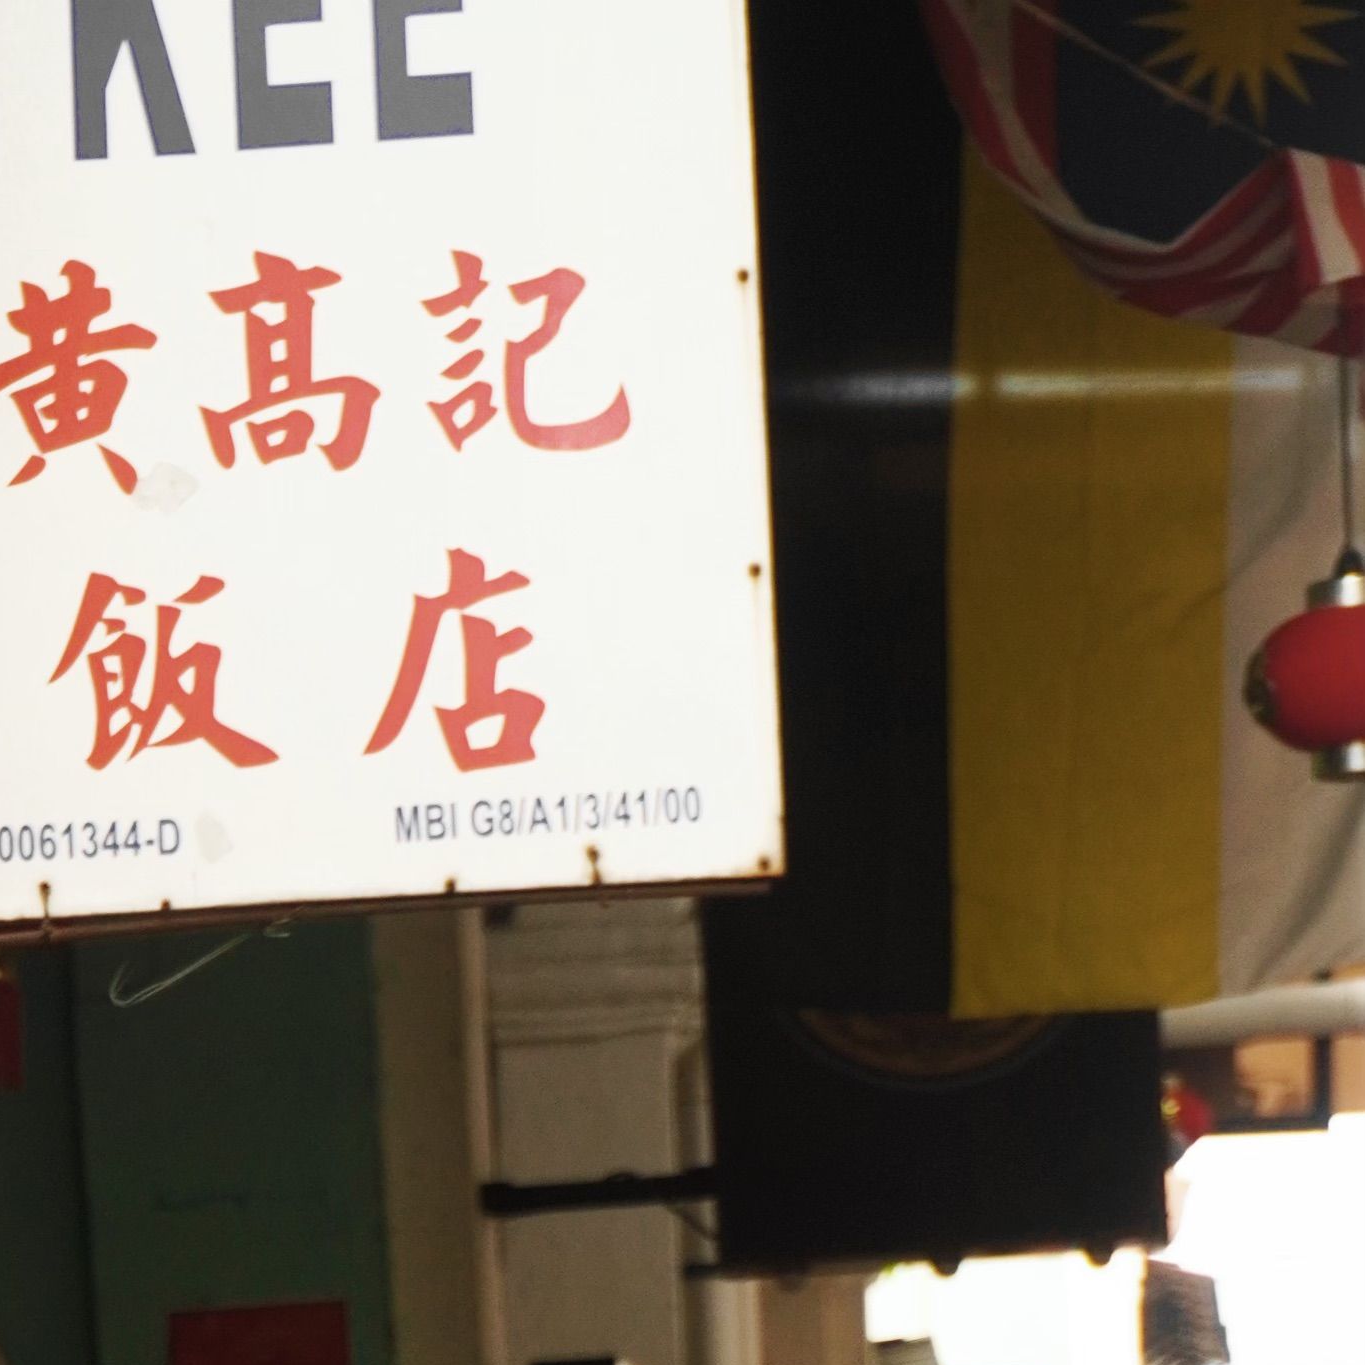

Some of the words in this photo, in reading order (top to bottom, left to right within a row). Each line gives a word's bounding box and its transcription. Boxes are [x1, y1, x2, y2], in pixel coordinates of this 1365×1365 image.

[48, 548, 547, 772] 飯店
[394, 803, 458, 843] MBI
[470, 785, 702, 837] G8/A1/3/41/00
